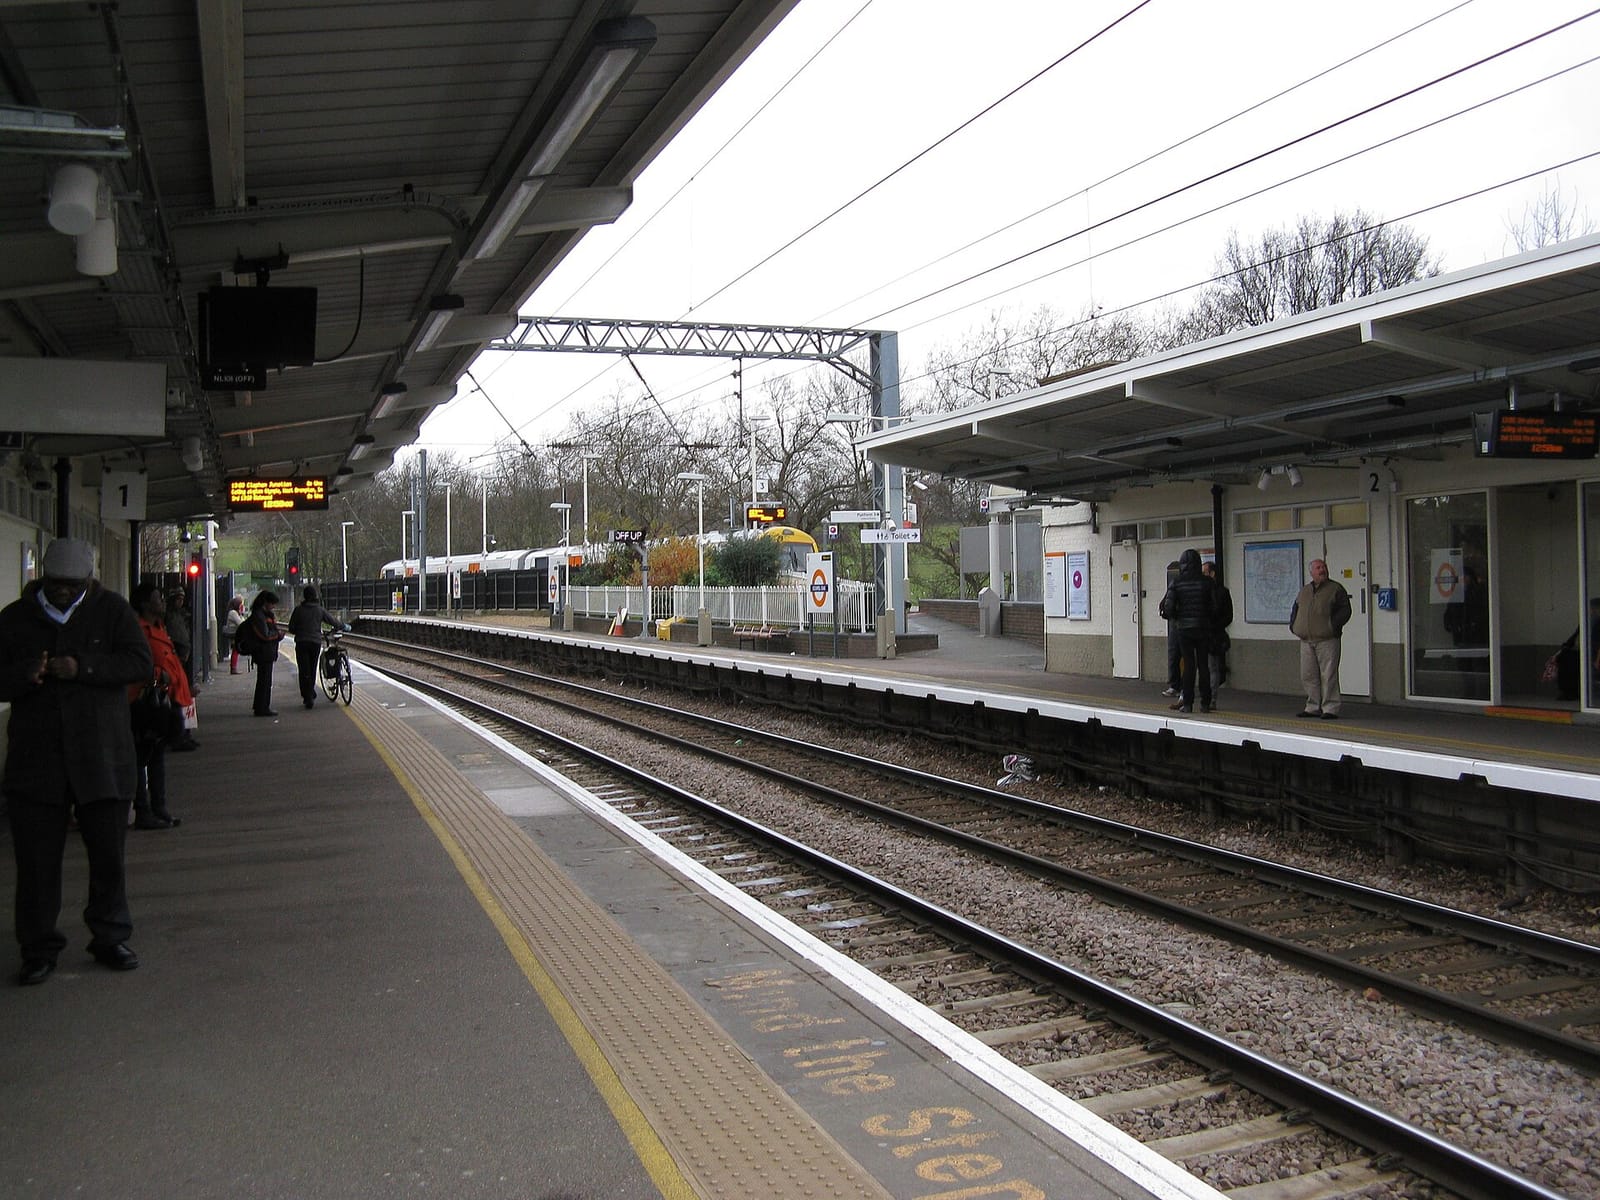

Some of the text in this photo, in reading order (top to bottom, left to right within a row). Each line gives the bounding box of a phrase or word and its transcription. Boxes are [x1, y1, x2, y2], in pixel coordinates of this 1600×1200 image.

[235, 375, 255, 384] (OFF)
[759, 482, 765, 490] 3
[1369, 473, 1379, 492] 2
[118, 484, 128, 507] 1
[615, 531, 642, 540] OFF UP
[891, 532, 910, 540] Toilet
